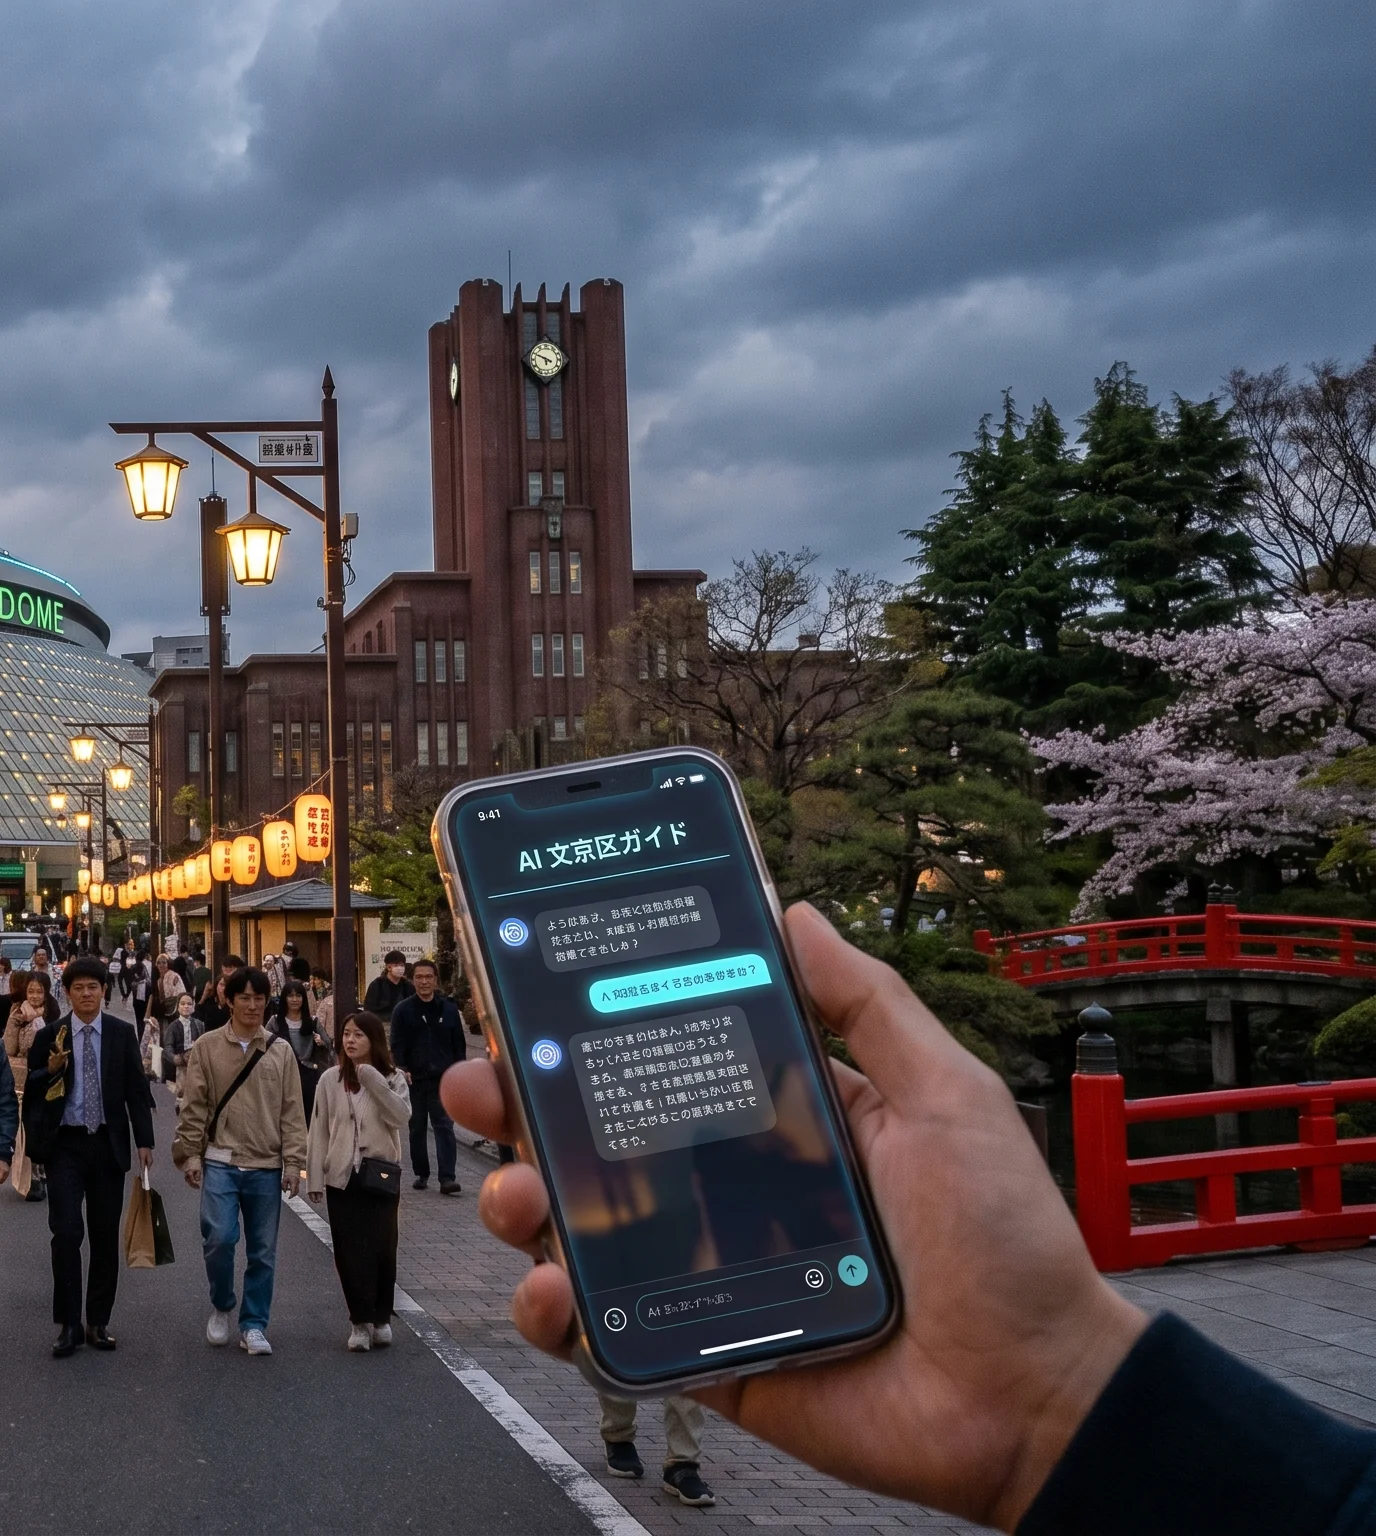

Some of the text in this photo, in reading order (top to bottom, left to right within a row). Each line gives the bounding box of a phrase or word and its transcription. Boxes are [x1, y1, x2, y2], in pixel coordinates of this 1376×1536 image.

[478, 809, 501, 821] 9:41
[519, 821, 688, 873] AI 文京区ガイド
